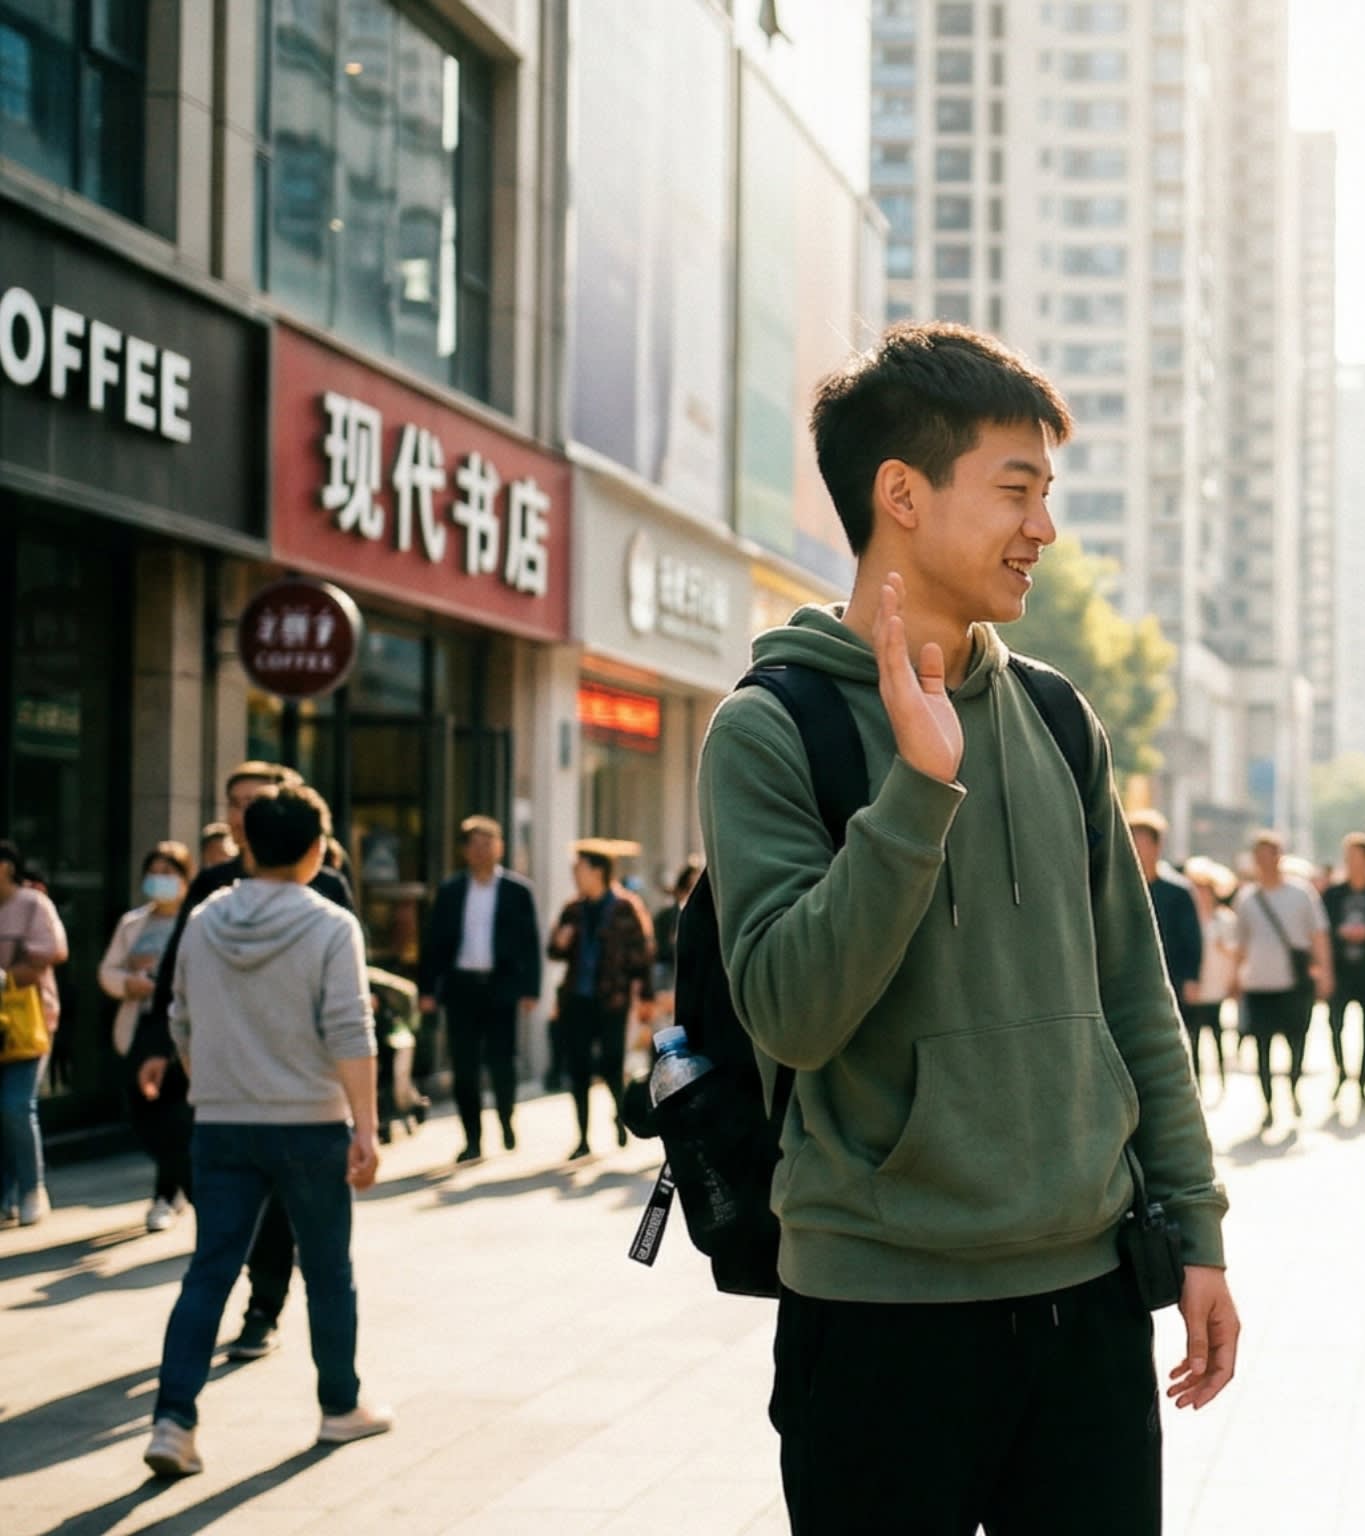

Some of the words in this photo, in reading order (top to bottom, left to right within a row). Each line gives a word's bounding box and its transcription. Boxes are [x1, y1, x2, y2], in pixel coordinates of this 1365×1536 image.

[0, 286, 192, 443] OFFEE
[321, 390, 551, 597] 现代书店
